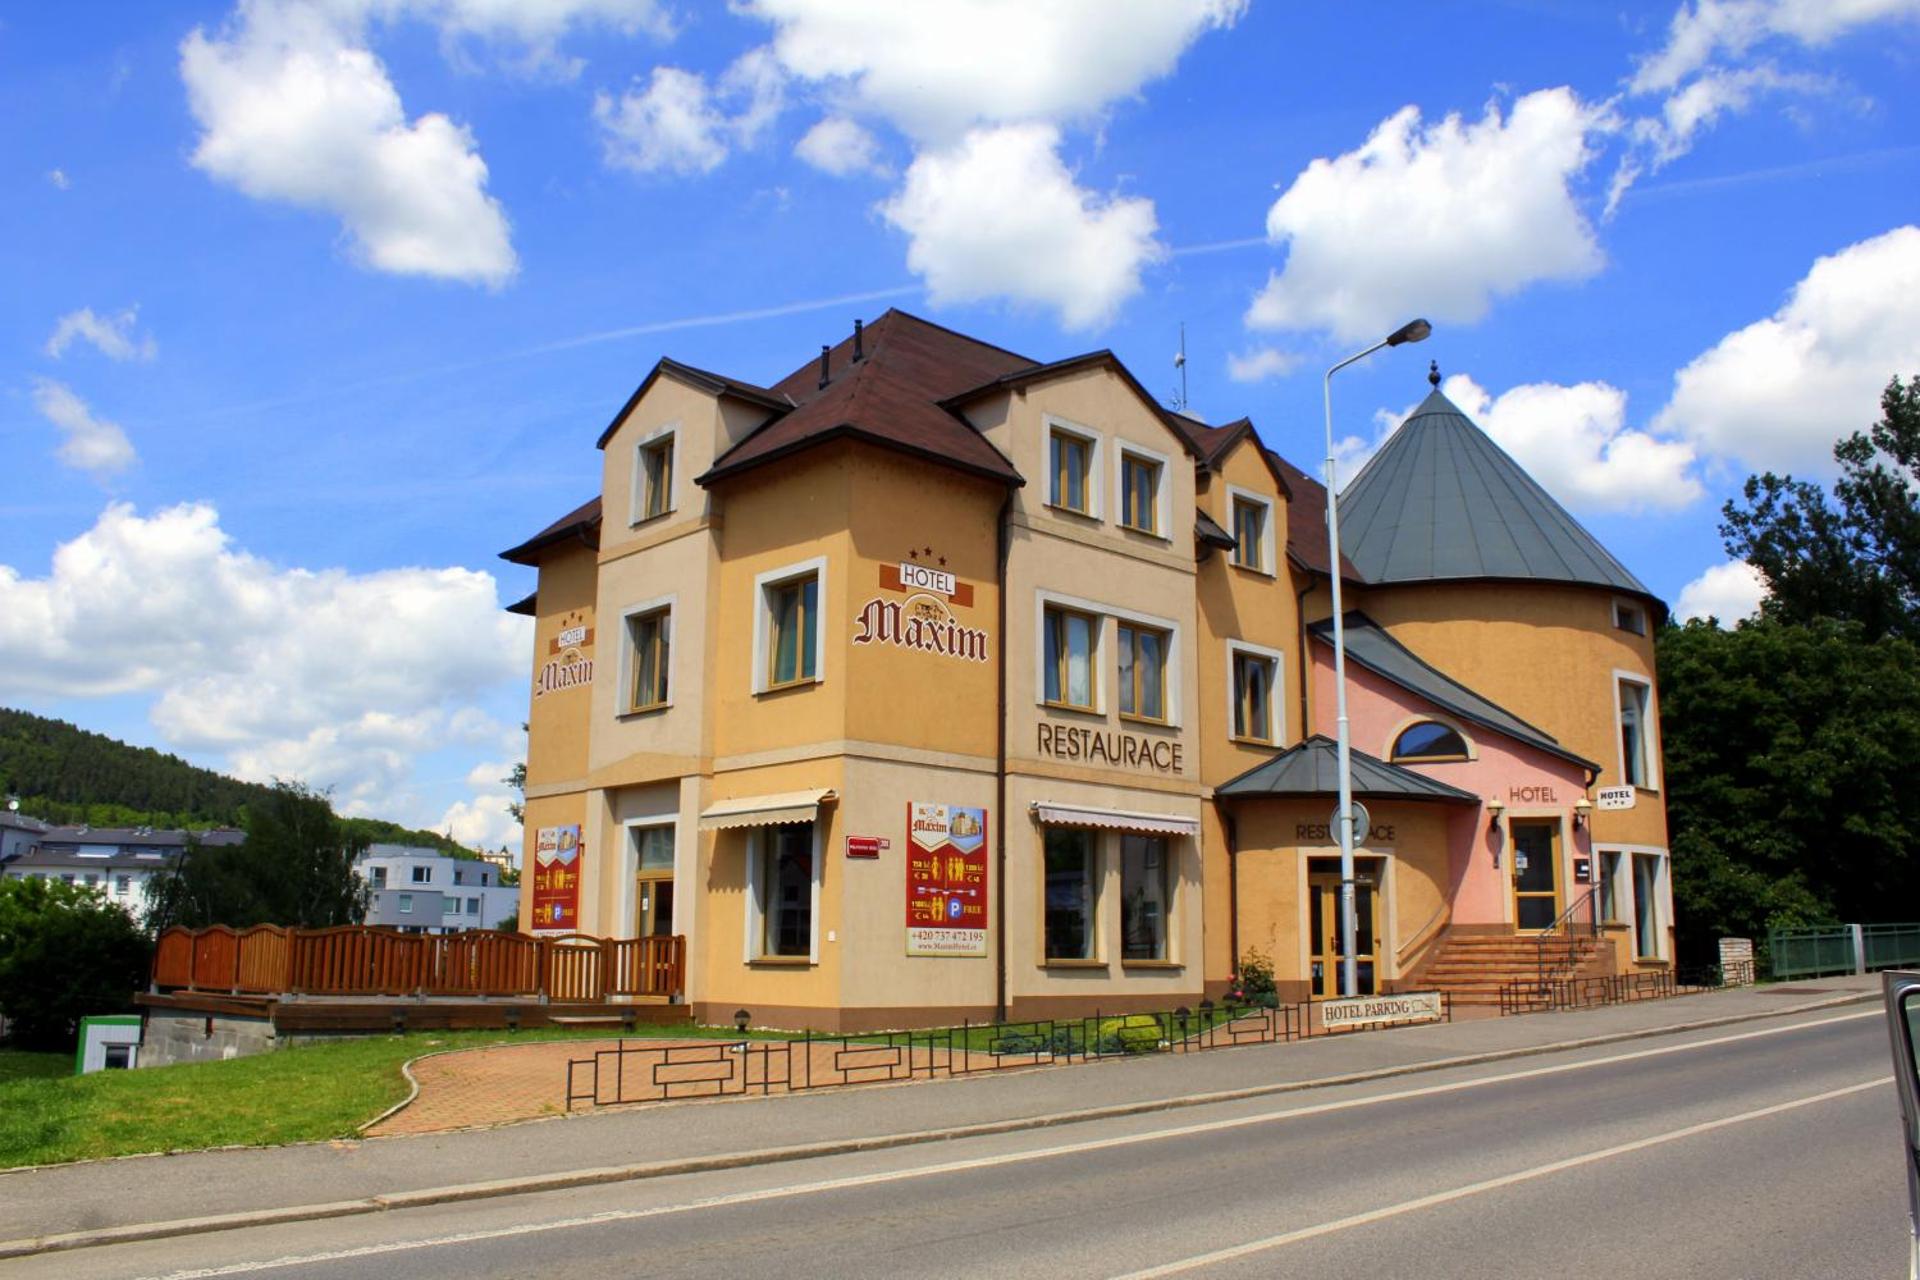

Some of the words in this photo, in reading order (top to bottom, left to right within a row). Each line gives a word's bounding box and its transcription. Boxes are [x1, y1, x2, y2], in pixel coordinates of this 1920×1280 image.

[904, 565, 952, 593] HOTEL
[854, 599, 987, 661] Maxim
[1038, 722, 1182, 771] RESTAURACE
[1510, 787, 1557, 802] HOTEL
[1600, 790, 1630, 799] HOTEL
[912, 819, 947, 832] Maxim
[1296, 824, 1395, 841] RESTACE
[969, 931, 984, 942] 195
[1325, 1005, 1362, 1021] HOTEL
[1365, 1000, 1409, 1016] PARKING
